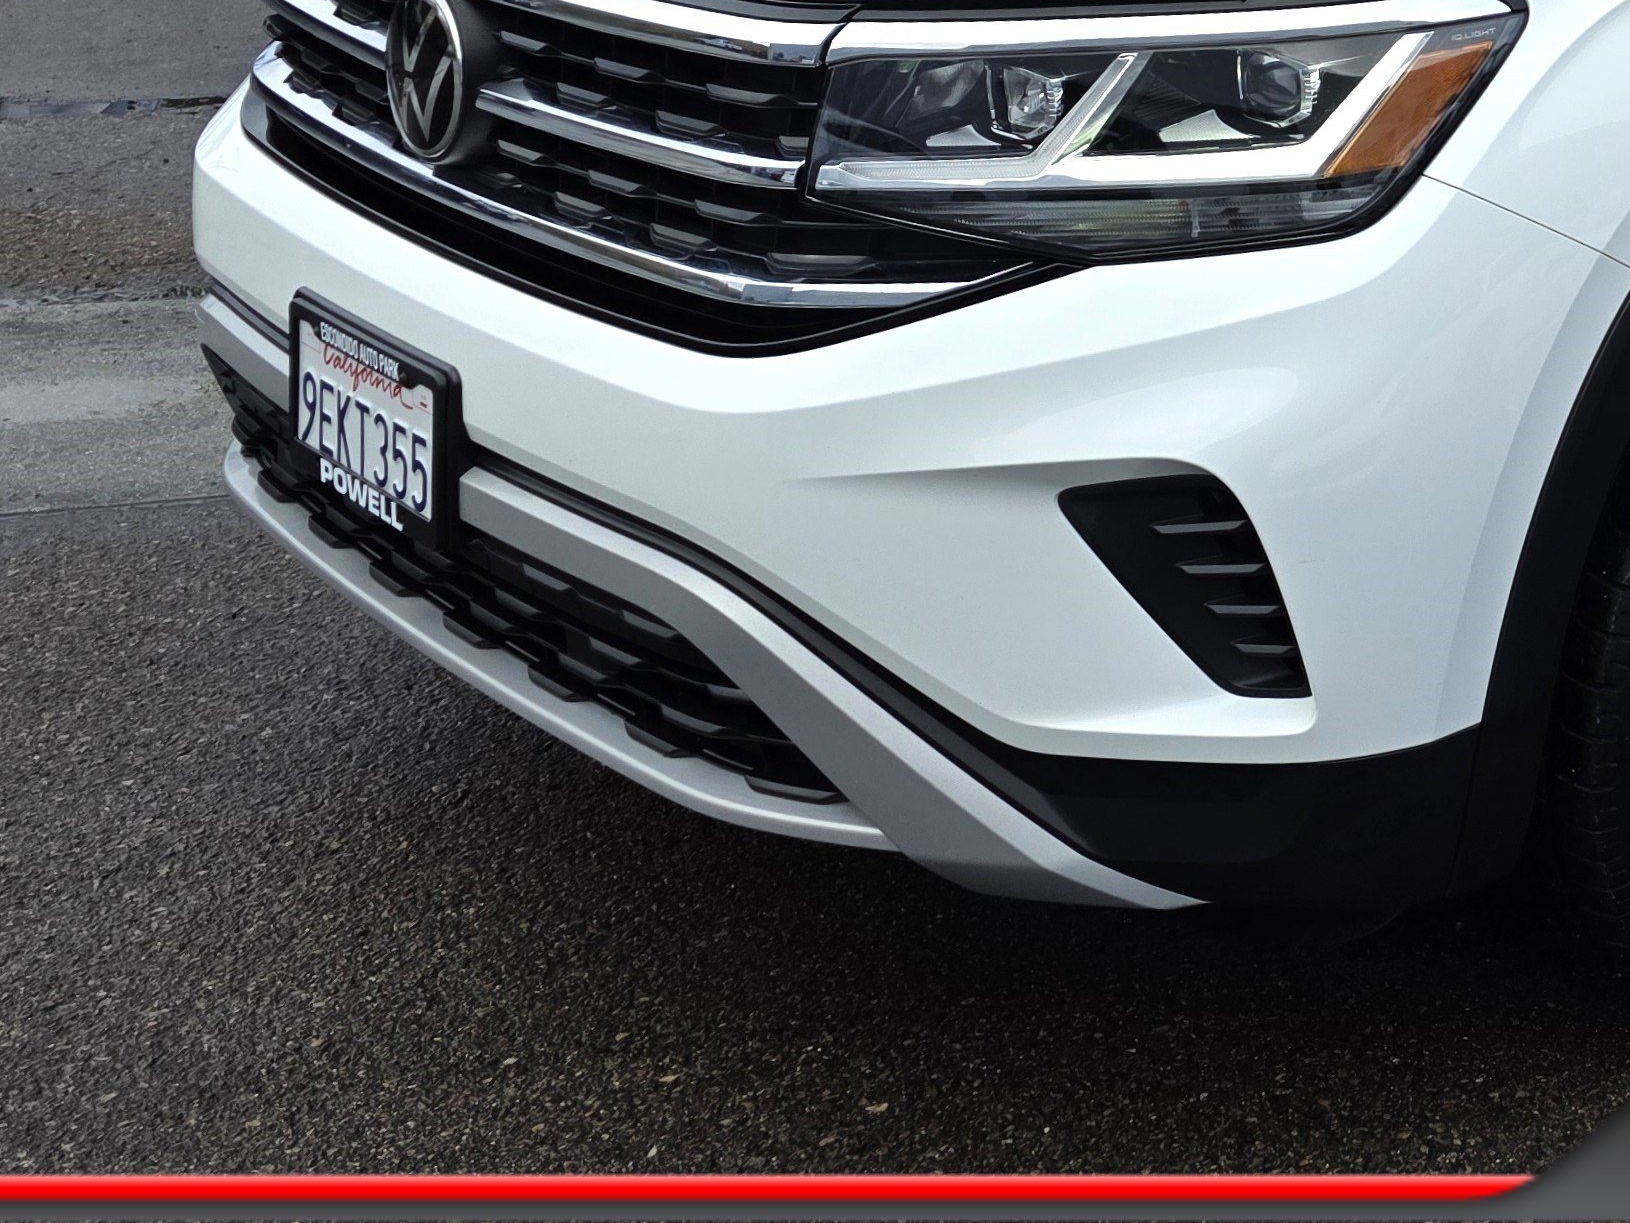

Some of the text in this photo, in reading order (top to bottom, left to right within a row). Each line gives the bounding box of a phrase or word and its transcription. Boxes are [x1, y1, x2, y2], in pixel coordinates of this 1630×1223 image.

[320, 322, 400, 381] ESCONDIDO AUTO PARK
[323, 343, 414, 410] California
[302, 370, 428, 514] 9EKT355
[320, 457, 404, 532] POWELL
